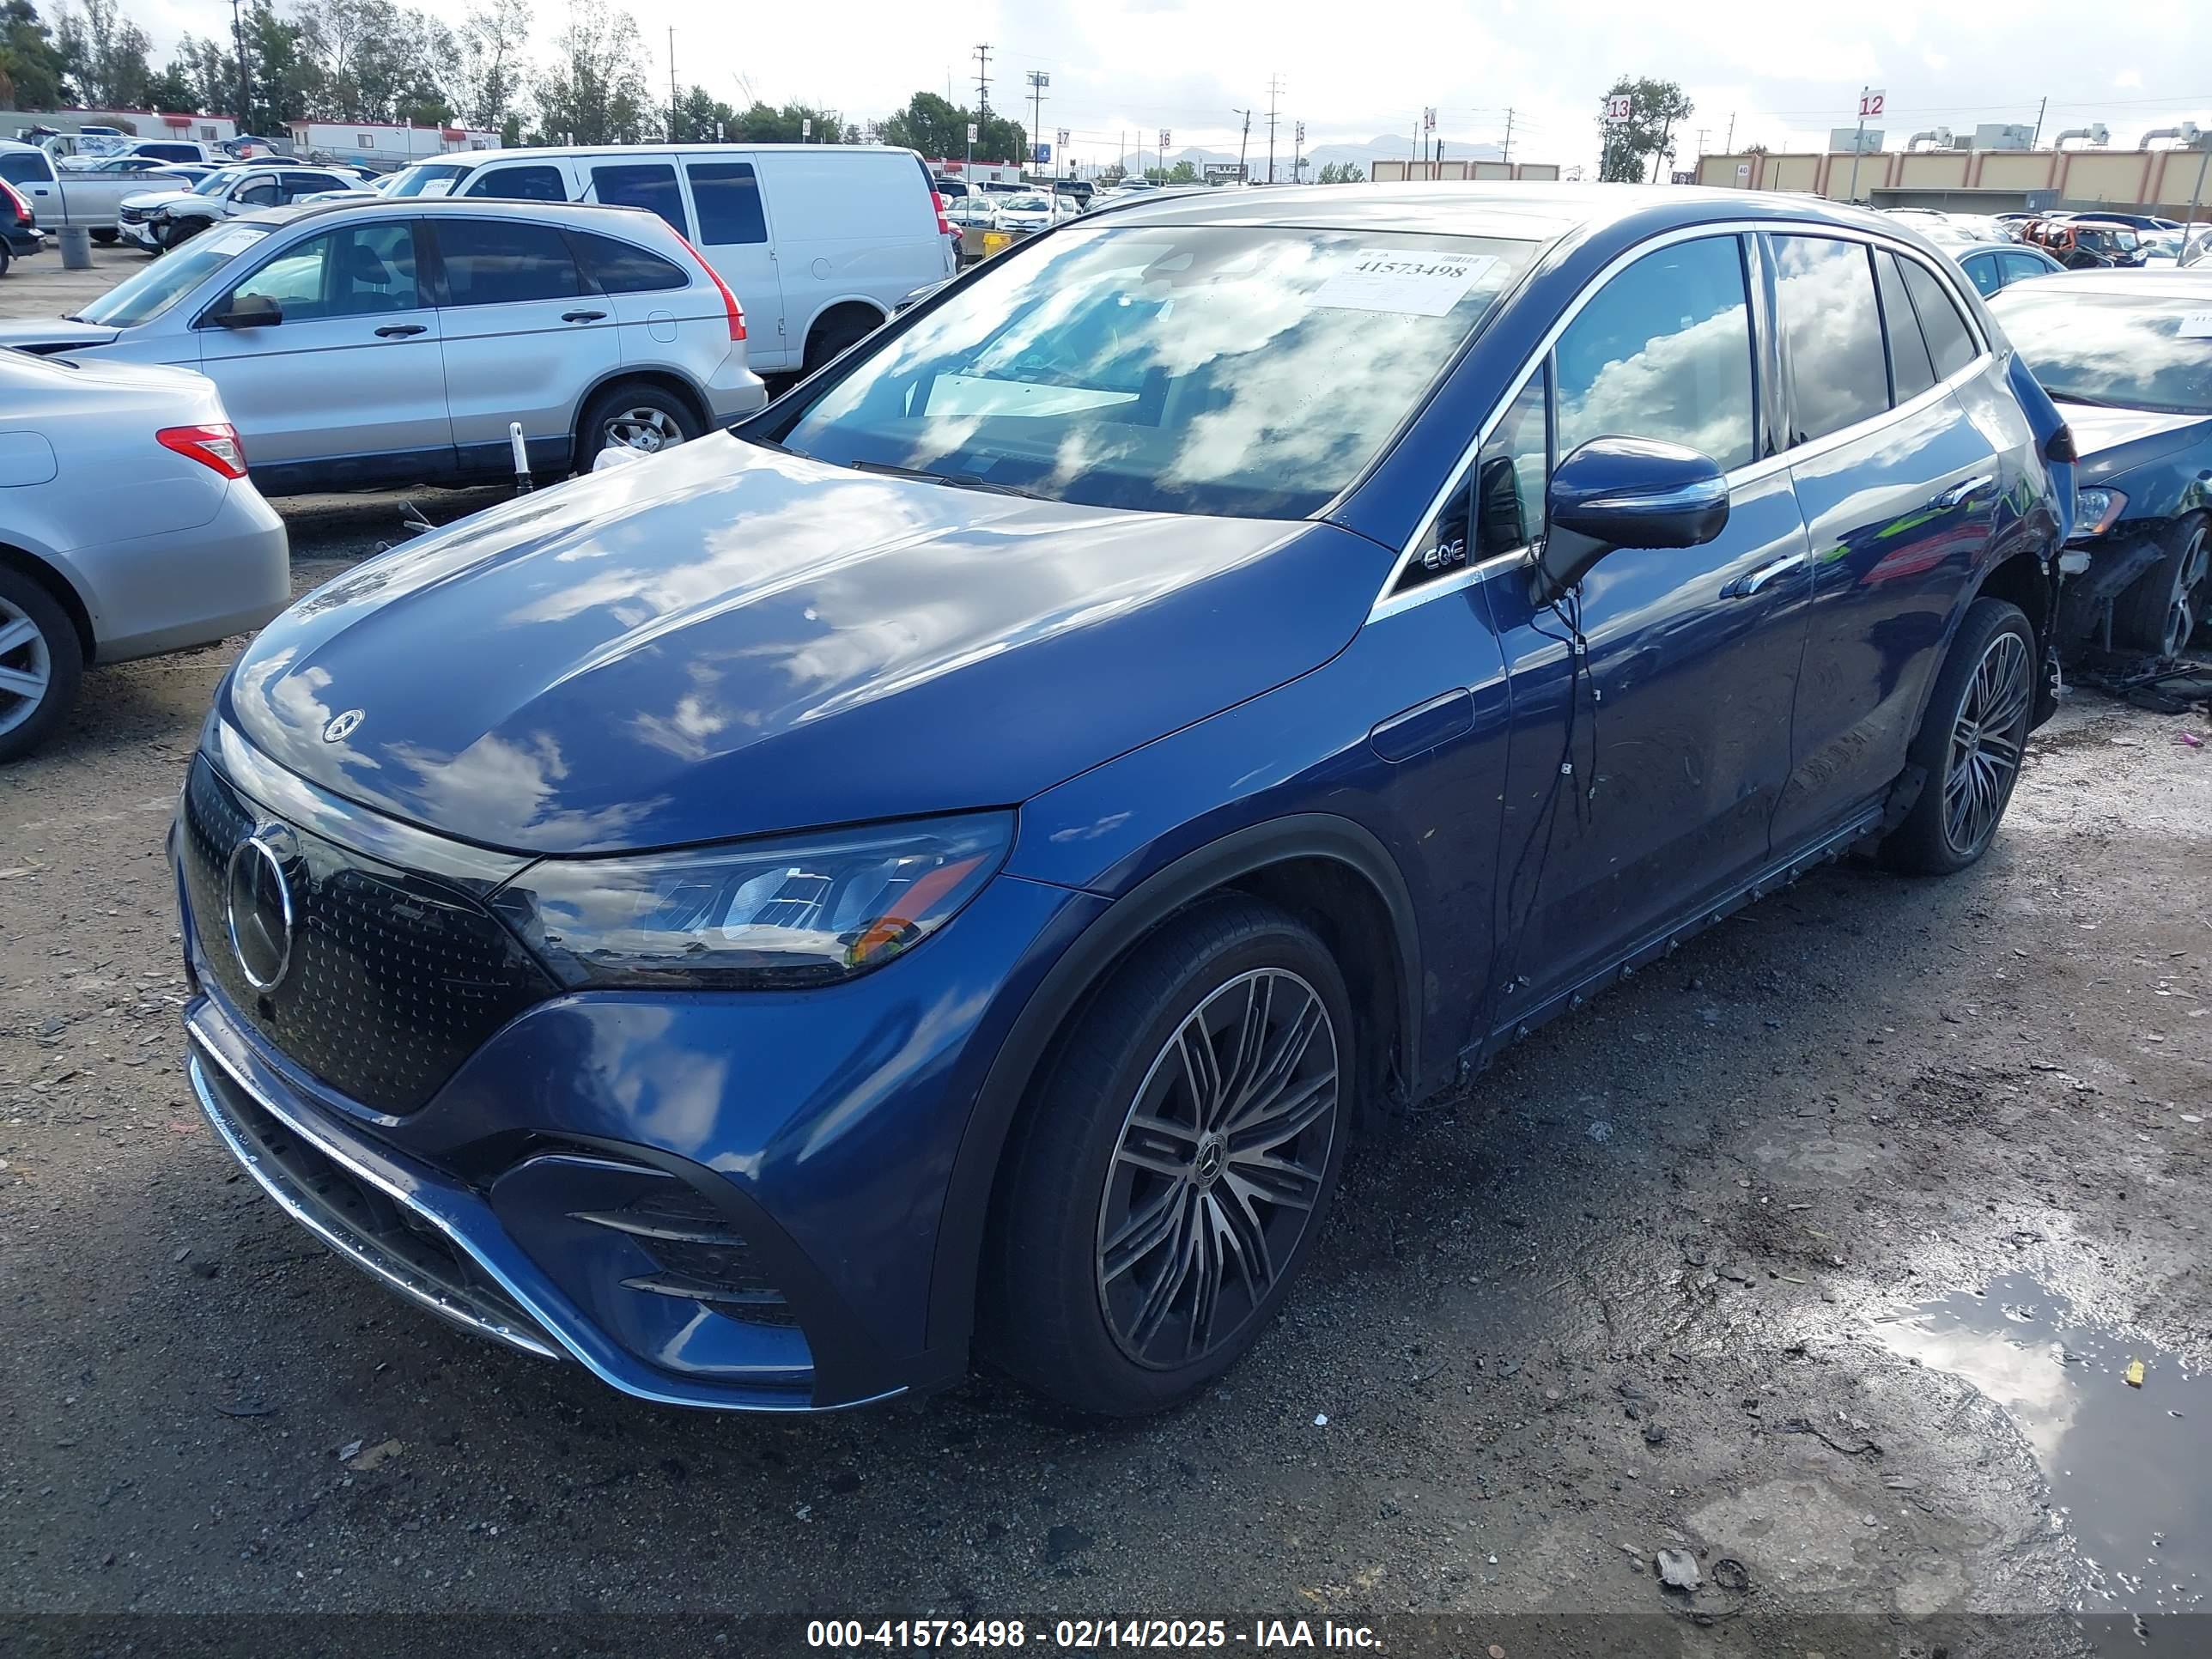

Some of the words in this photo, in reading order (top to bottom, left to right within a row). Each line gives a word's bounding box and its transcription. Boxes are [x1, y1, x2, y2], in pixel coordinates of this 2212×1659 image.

[1609, 100, 1629, 118] 13
[1859, 95, 1884, 115] 12
[1424, 112, 1436, 130] 14
[968, 128, 977, 139] 18
[1057, 132, 1070, 144] 17
[1159, 133, 1170, 146] 16
[1295, 126, 1305, 142] 15
[1354, 260, 1468, 278] 41573498
[1425, 538, 1466, 570] EQE
